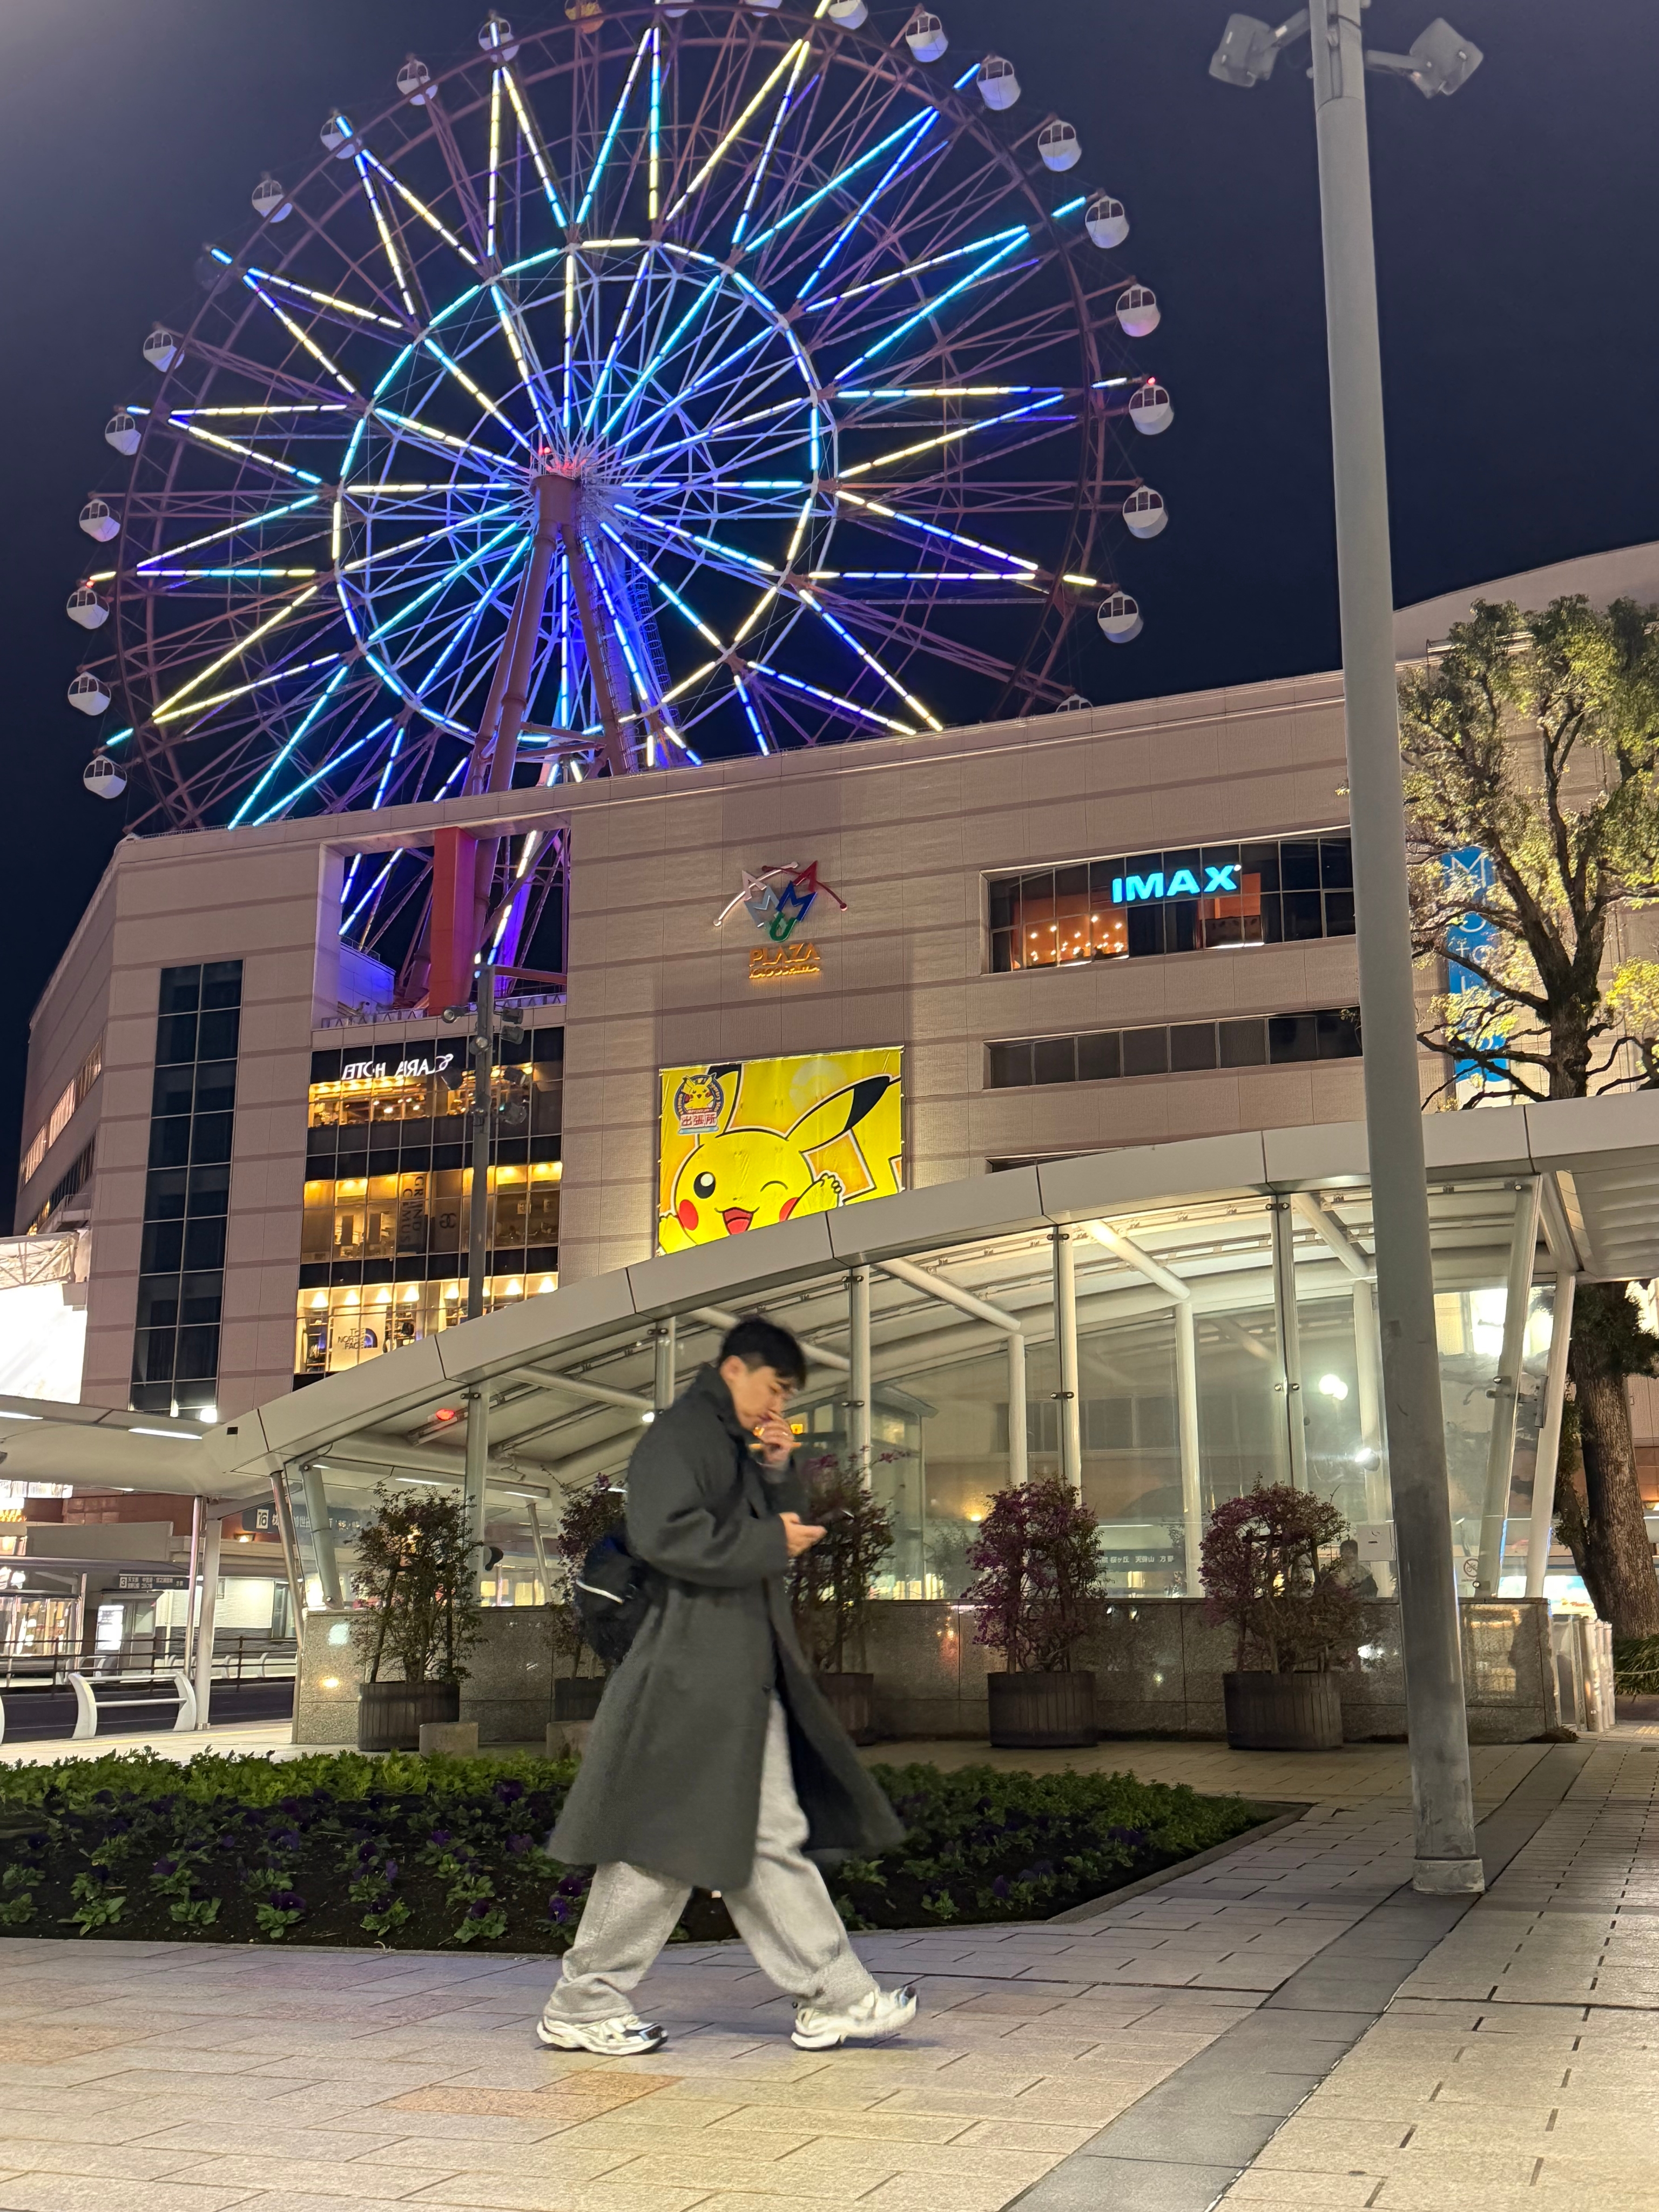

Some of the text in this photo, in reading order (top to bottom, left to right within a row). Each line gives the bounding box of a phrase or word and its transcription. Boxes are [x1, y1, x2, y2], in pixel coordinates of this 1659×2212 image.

[1112, 865, 1237, 903] IMAX
[749, 943, 820, 967] PLAZA
[682, 1114, 716, 1127] 出張所
[258, 1512, 268, 1527] 16
